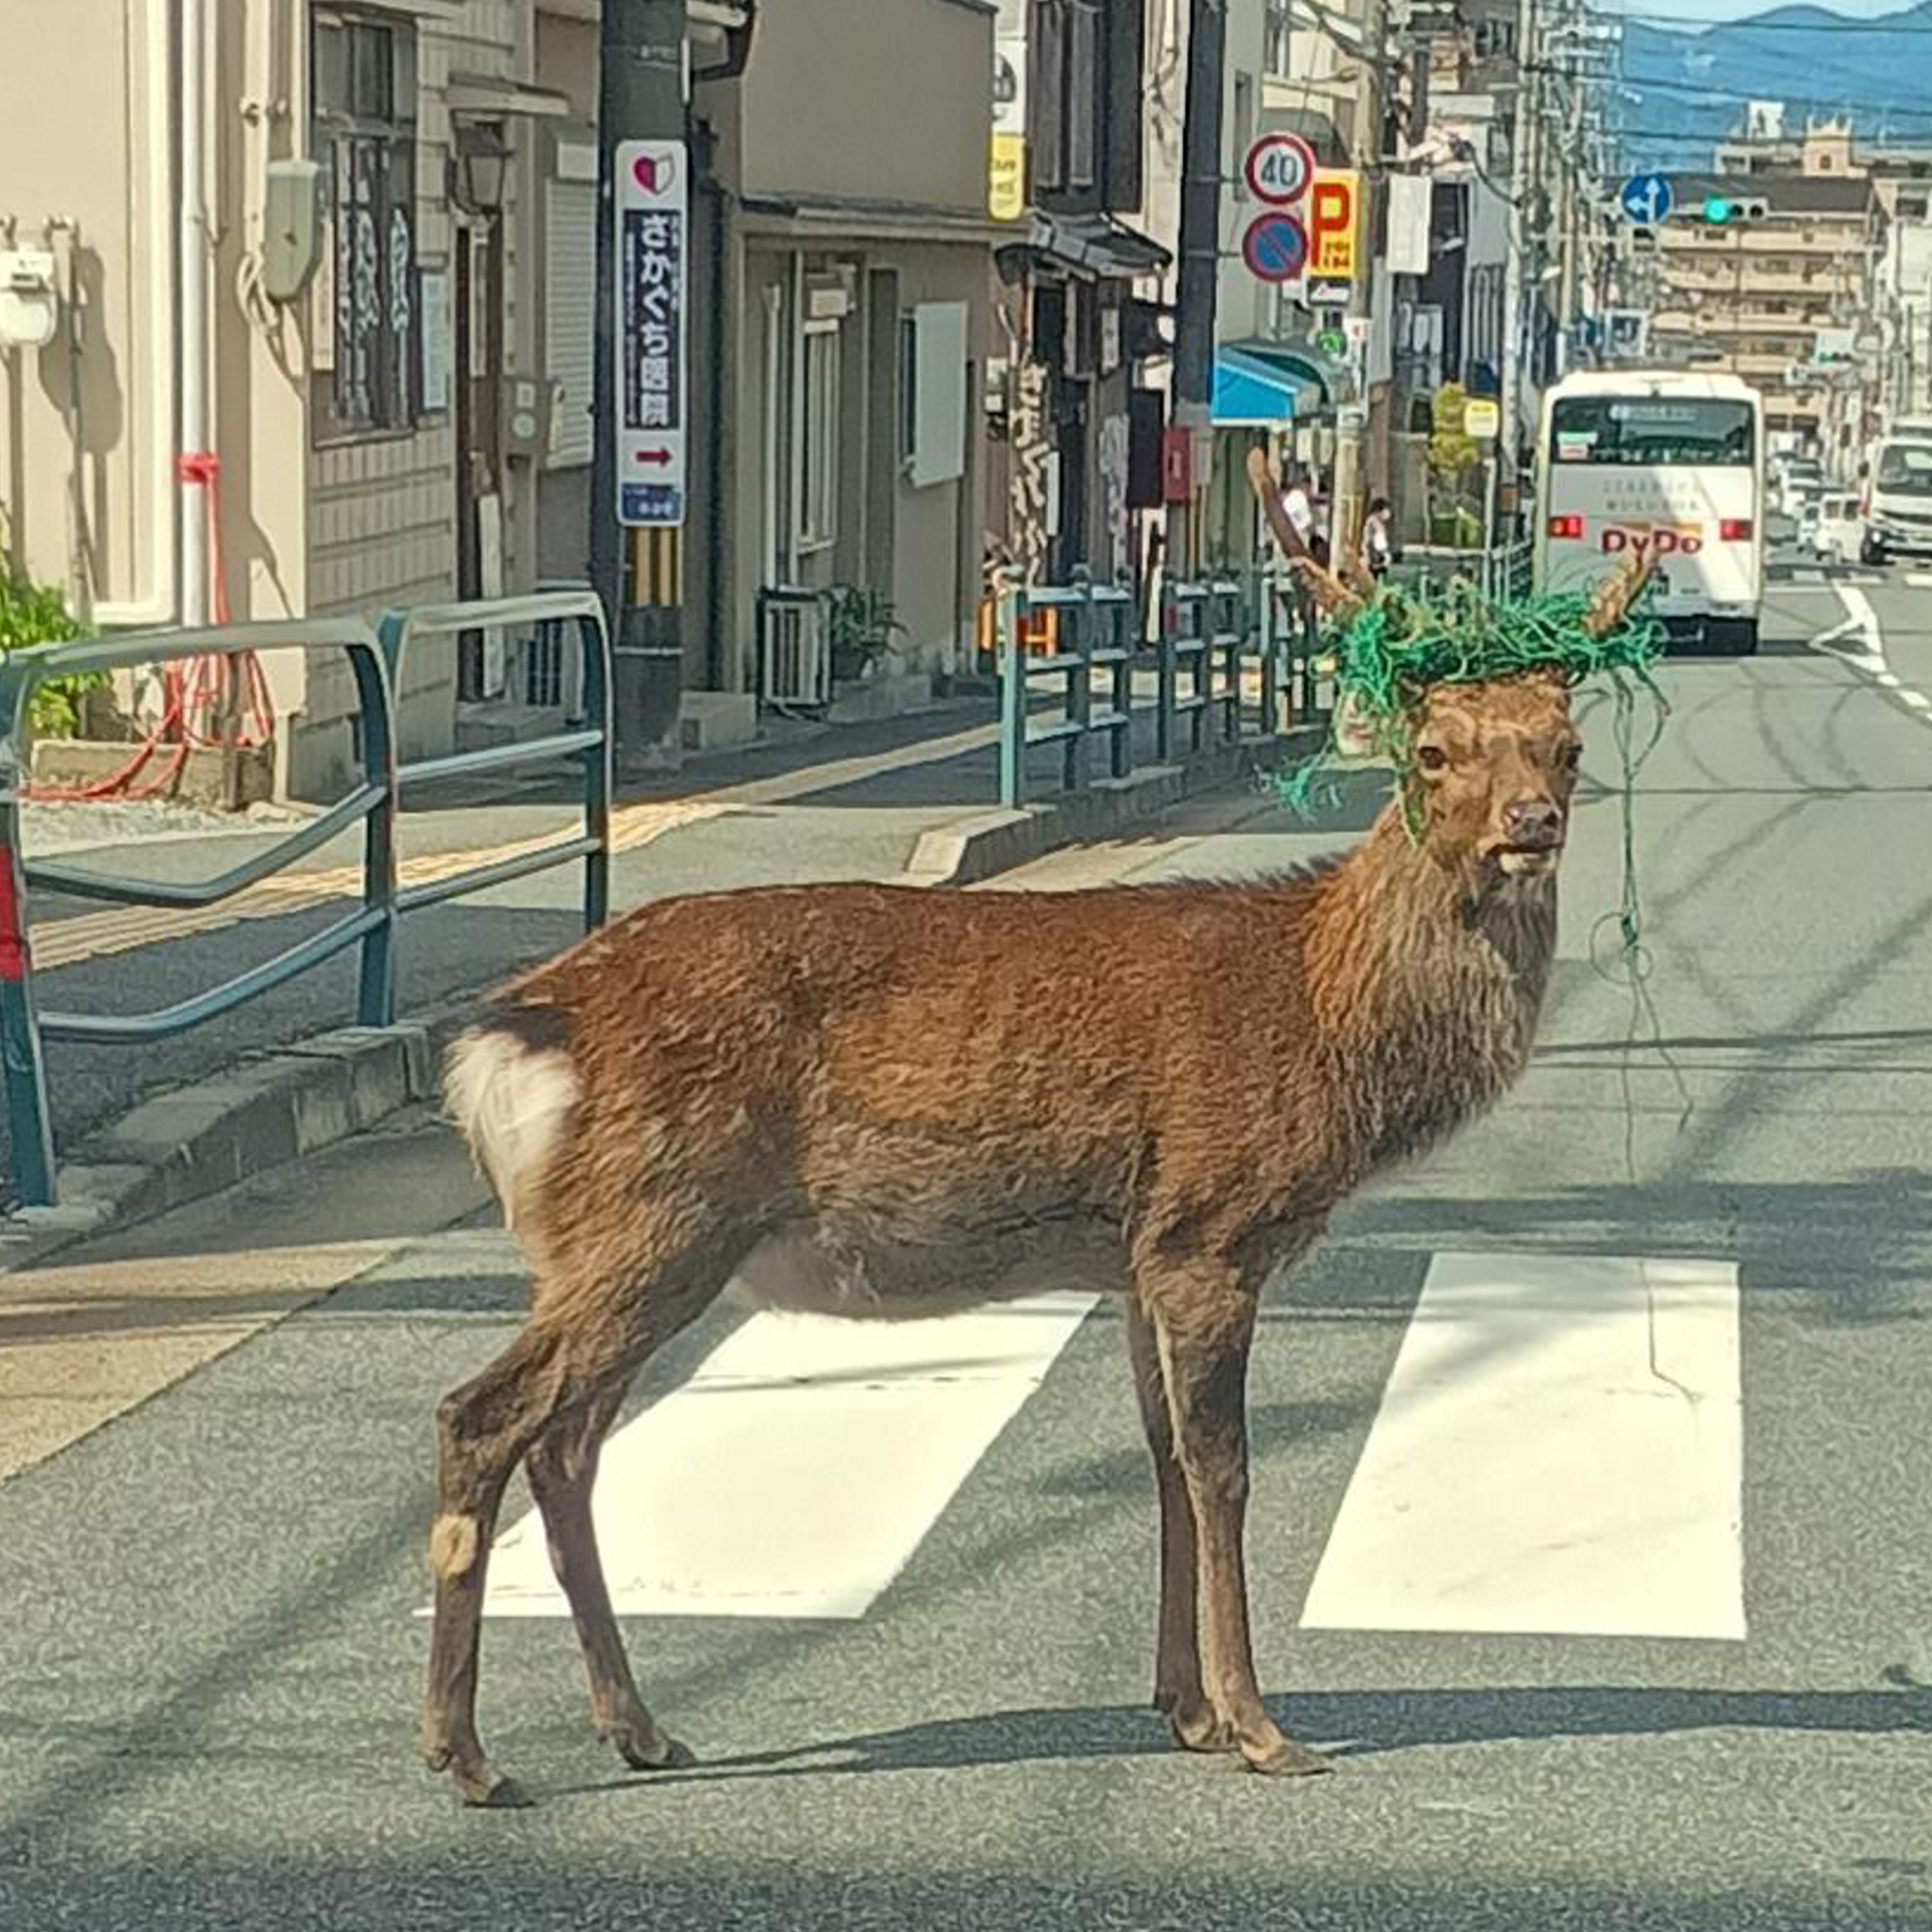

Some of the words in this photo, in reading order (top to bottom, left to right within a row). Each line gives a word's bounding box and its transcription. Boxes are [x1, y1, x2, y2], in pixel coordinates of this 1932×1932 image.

[1261, 155, 1298, 186] 40
[1311, 183, 1350, 267] P
[1602, 529, 1703, 556] DyDo
